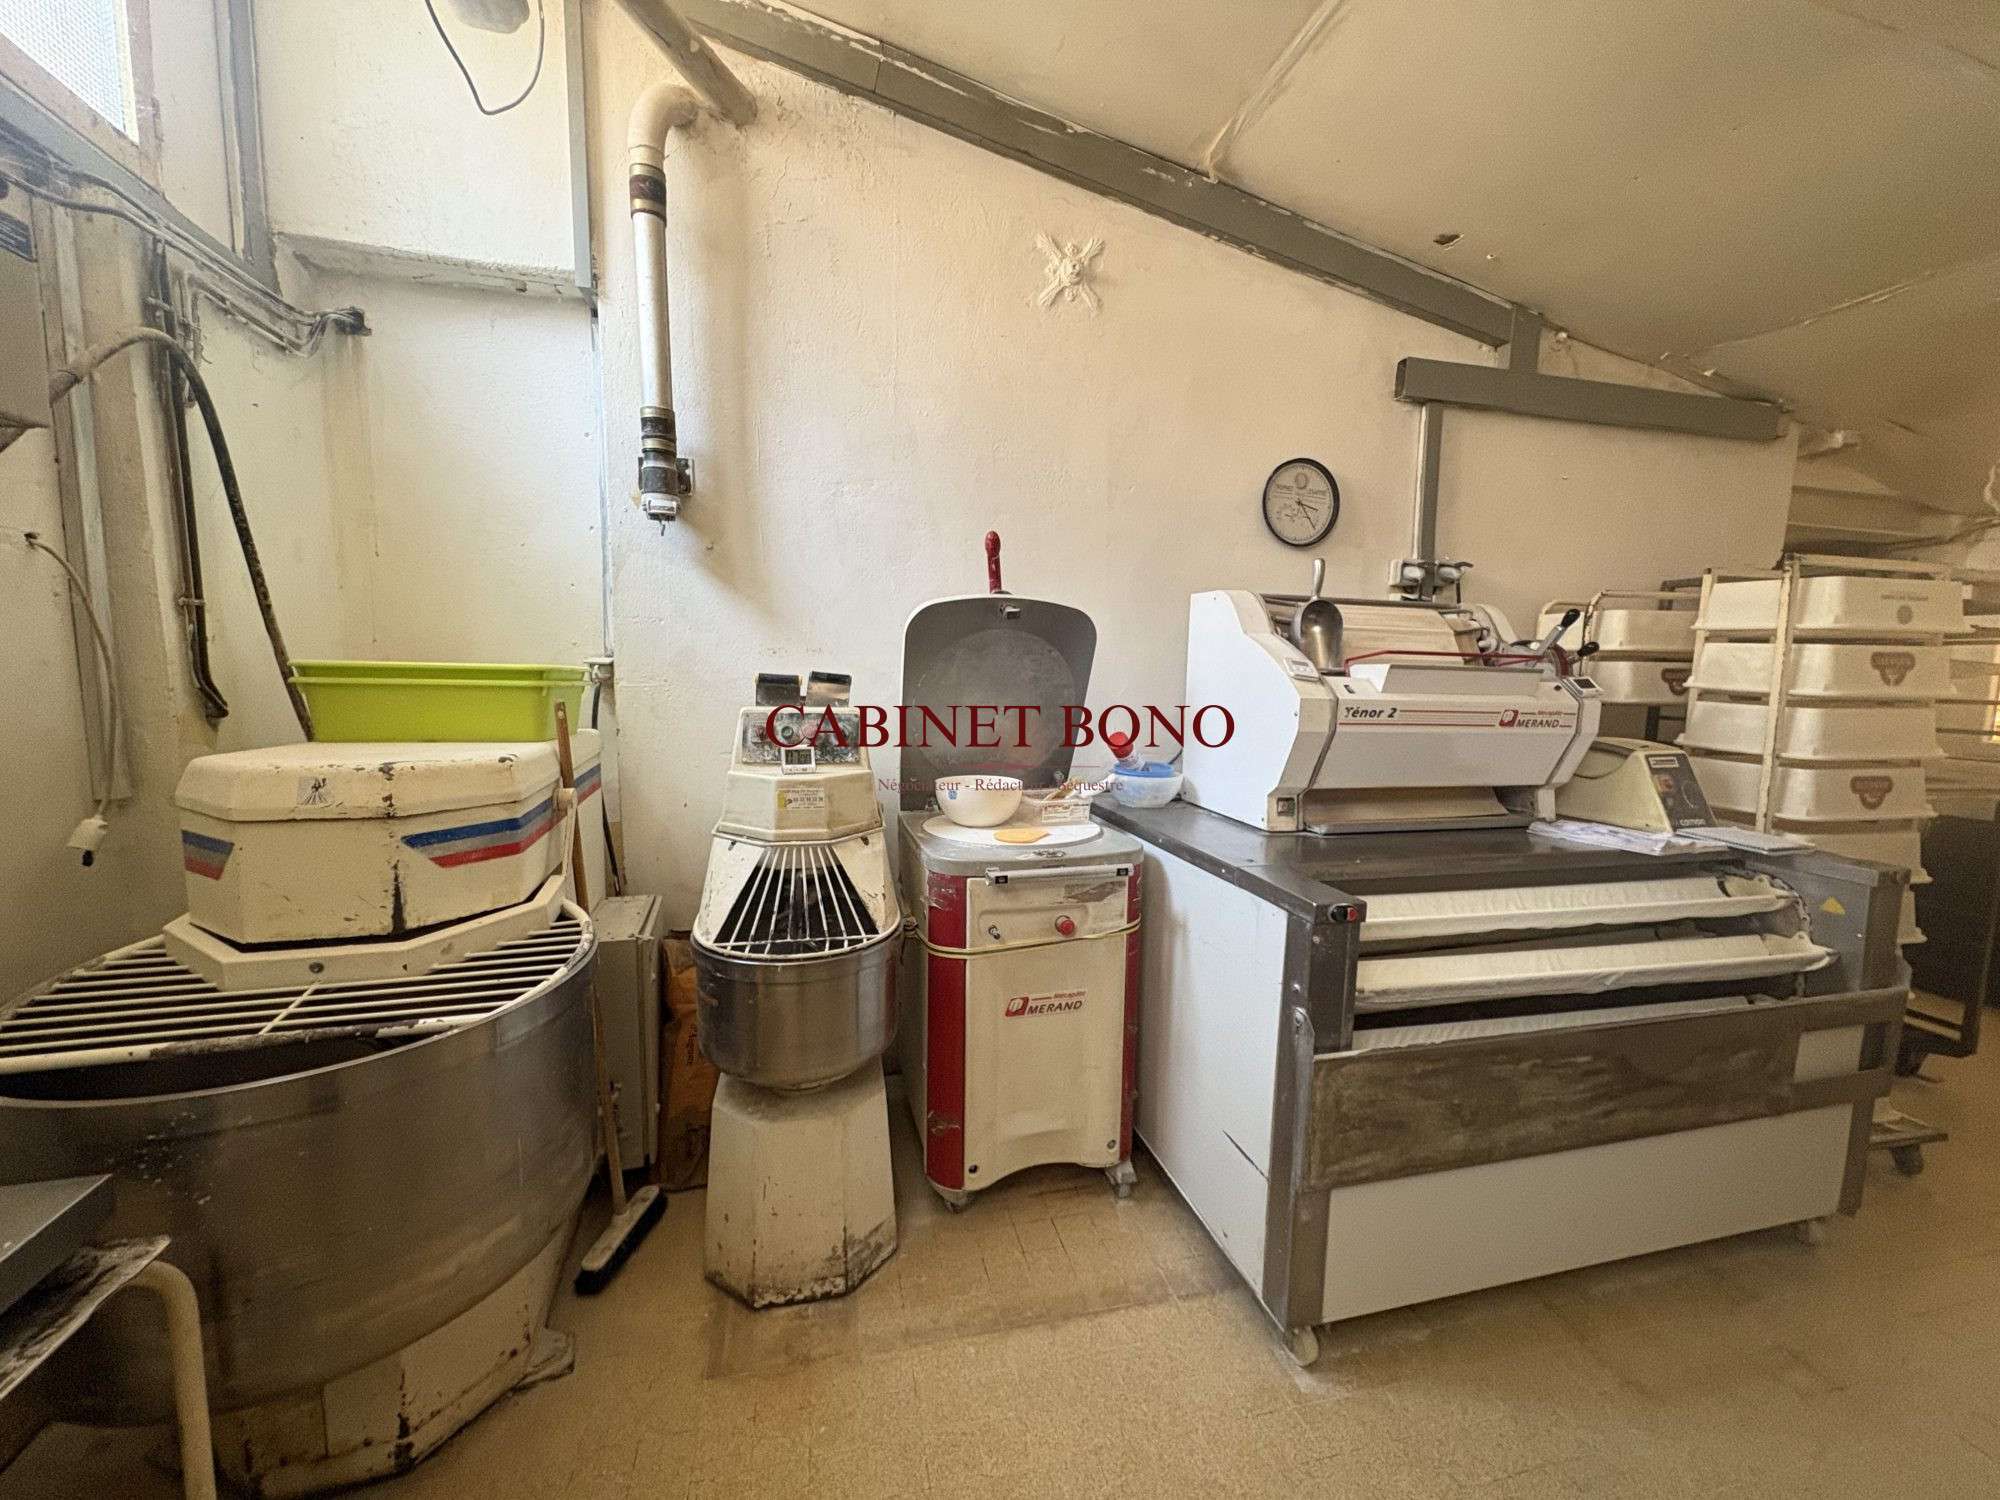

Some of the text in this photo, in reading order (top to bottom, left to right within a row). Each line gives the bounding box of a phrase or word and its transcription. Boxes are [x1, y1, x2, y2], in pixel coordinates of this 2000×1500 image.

[1344, 706, 1398, 719] Ténor 2
[1515, 719, 1560, 728] MERAND
[1026, 1000, 1083, 1015] MERAND
